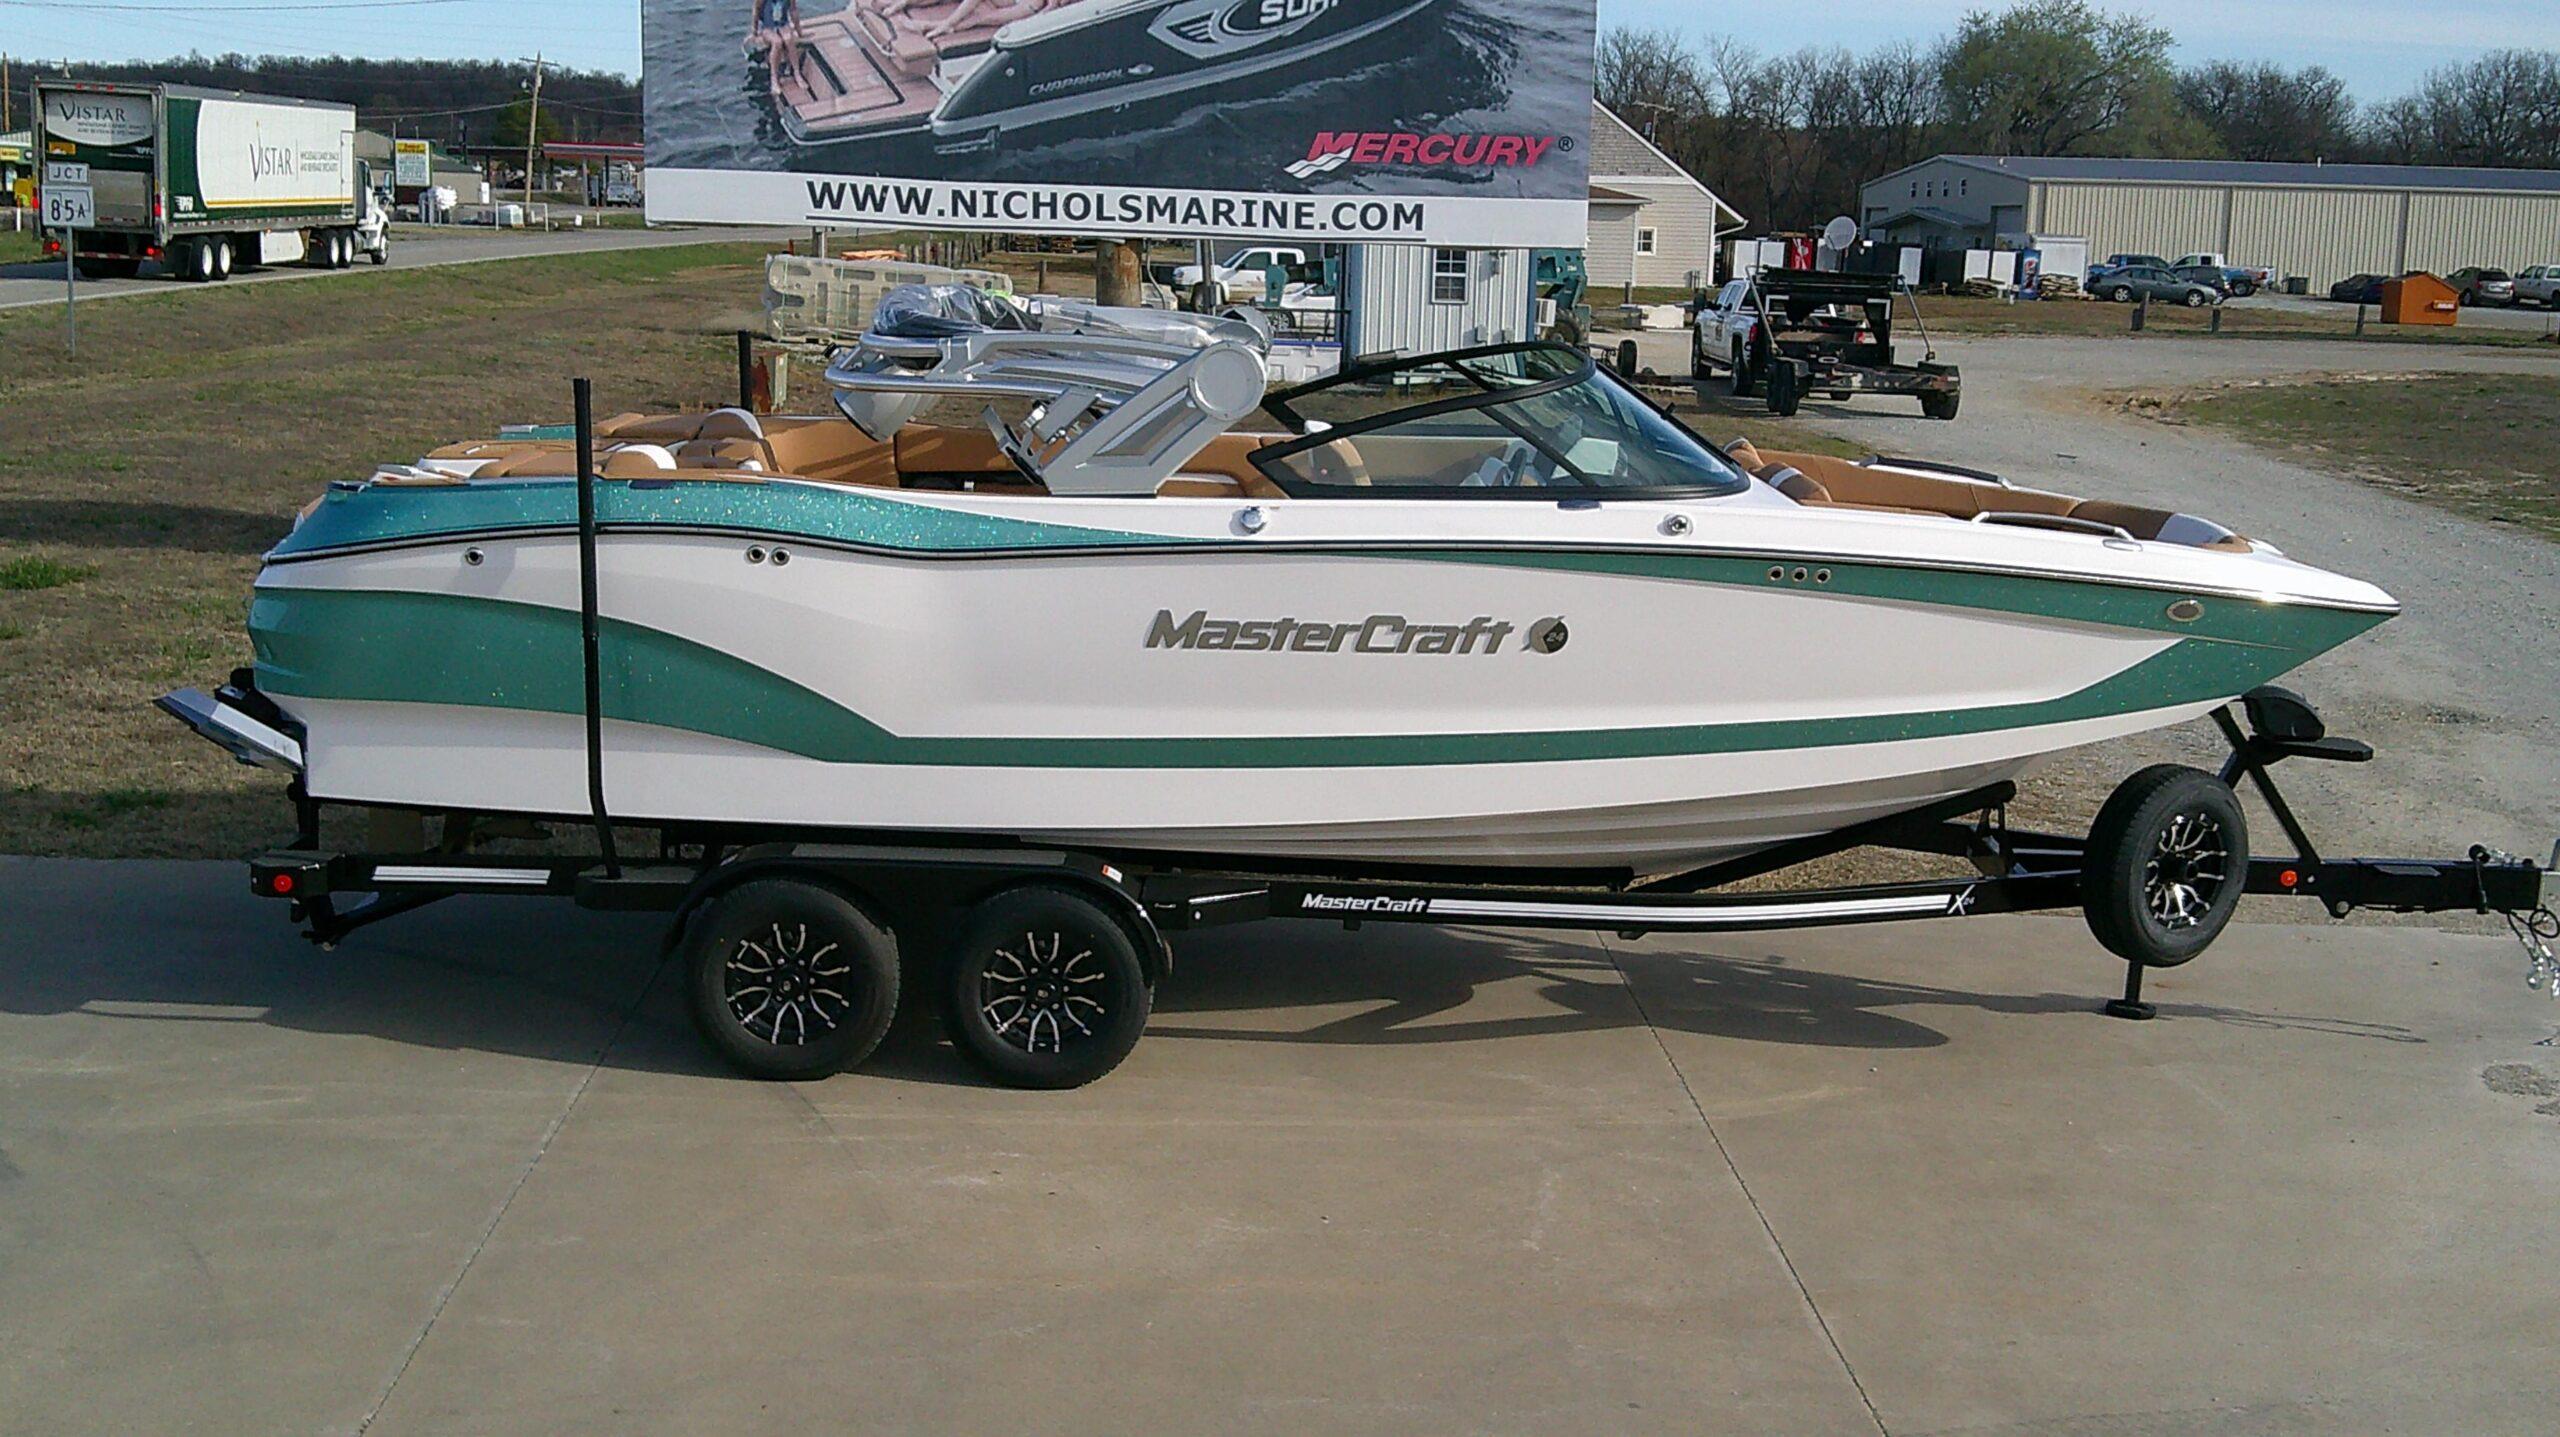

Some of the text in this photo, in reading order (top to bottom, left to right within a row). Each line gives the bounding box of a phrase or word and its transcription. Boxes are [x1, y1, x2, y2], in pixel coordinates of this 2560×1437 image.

[1260, 0, 1339, 24] SUR
[59, 100, 126, 121] VISTAR
[249, 139, 293, 182] VISTAR
[1306, 131, 1556, 166] MERCURY
[53, 167, 83, 179] JCT
[806, 180, 1424, 232] WWW.NICHOLSMARINE.COM
[1144, 609, 1565, 654] MasterCraft 24
[1301, 893, 1427, 913] MasterCraft
